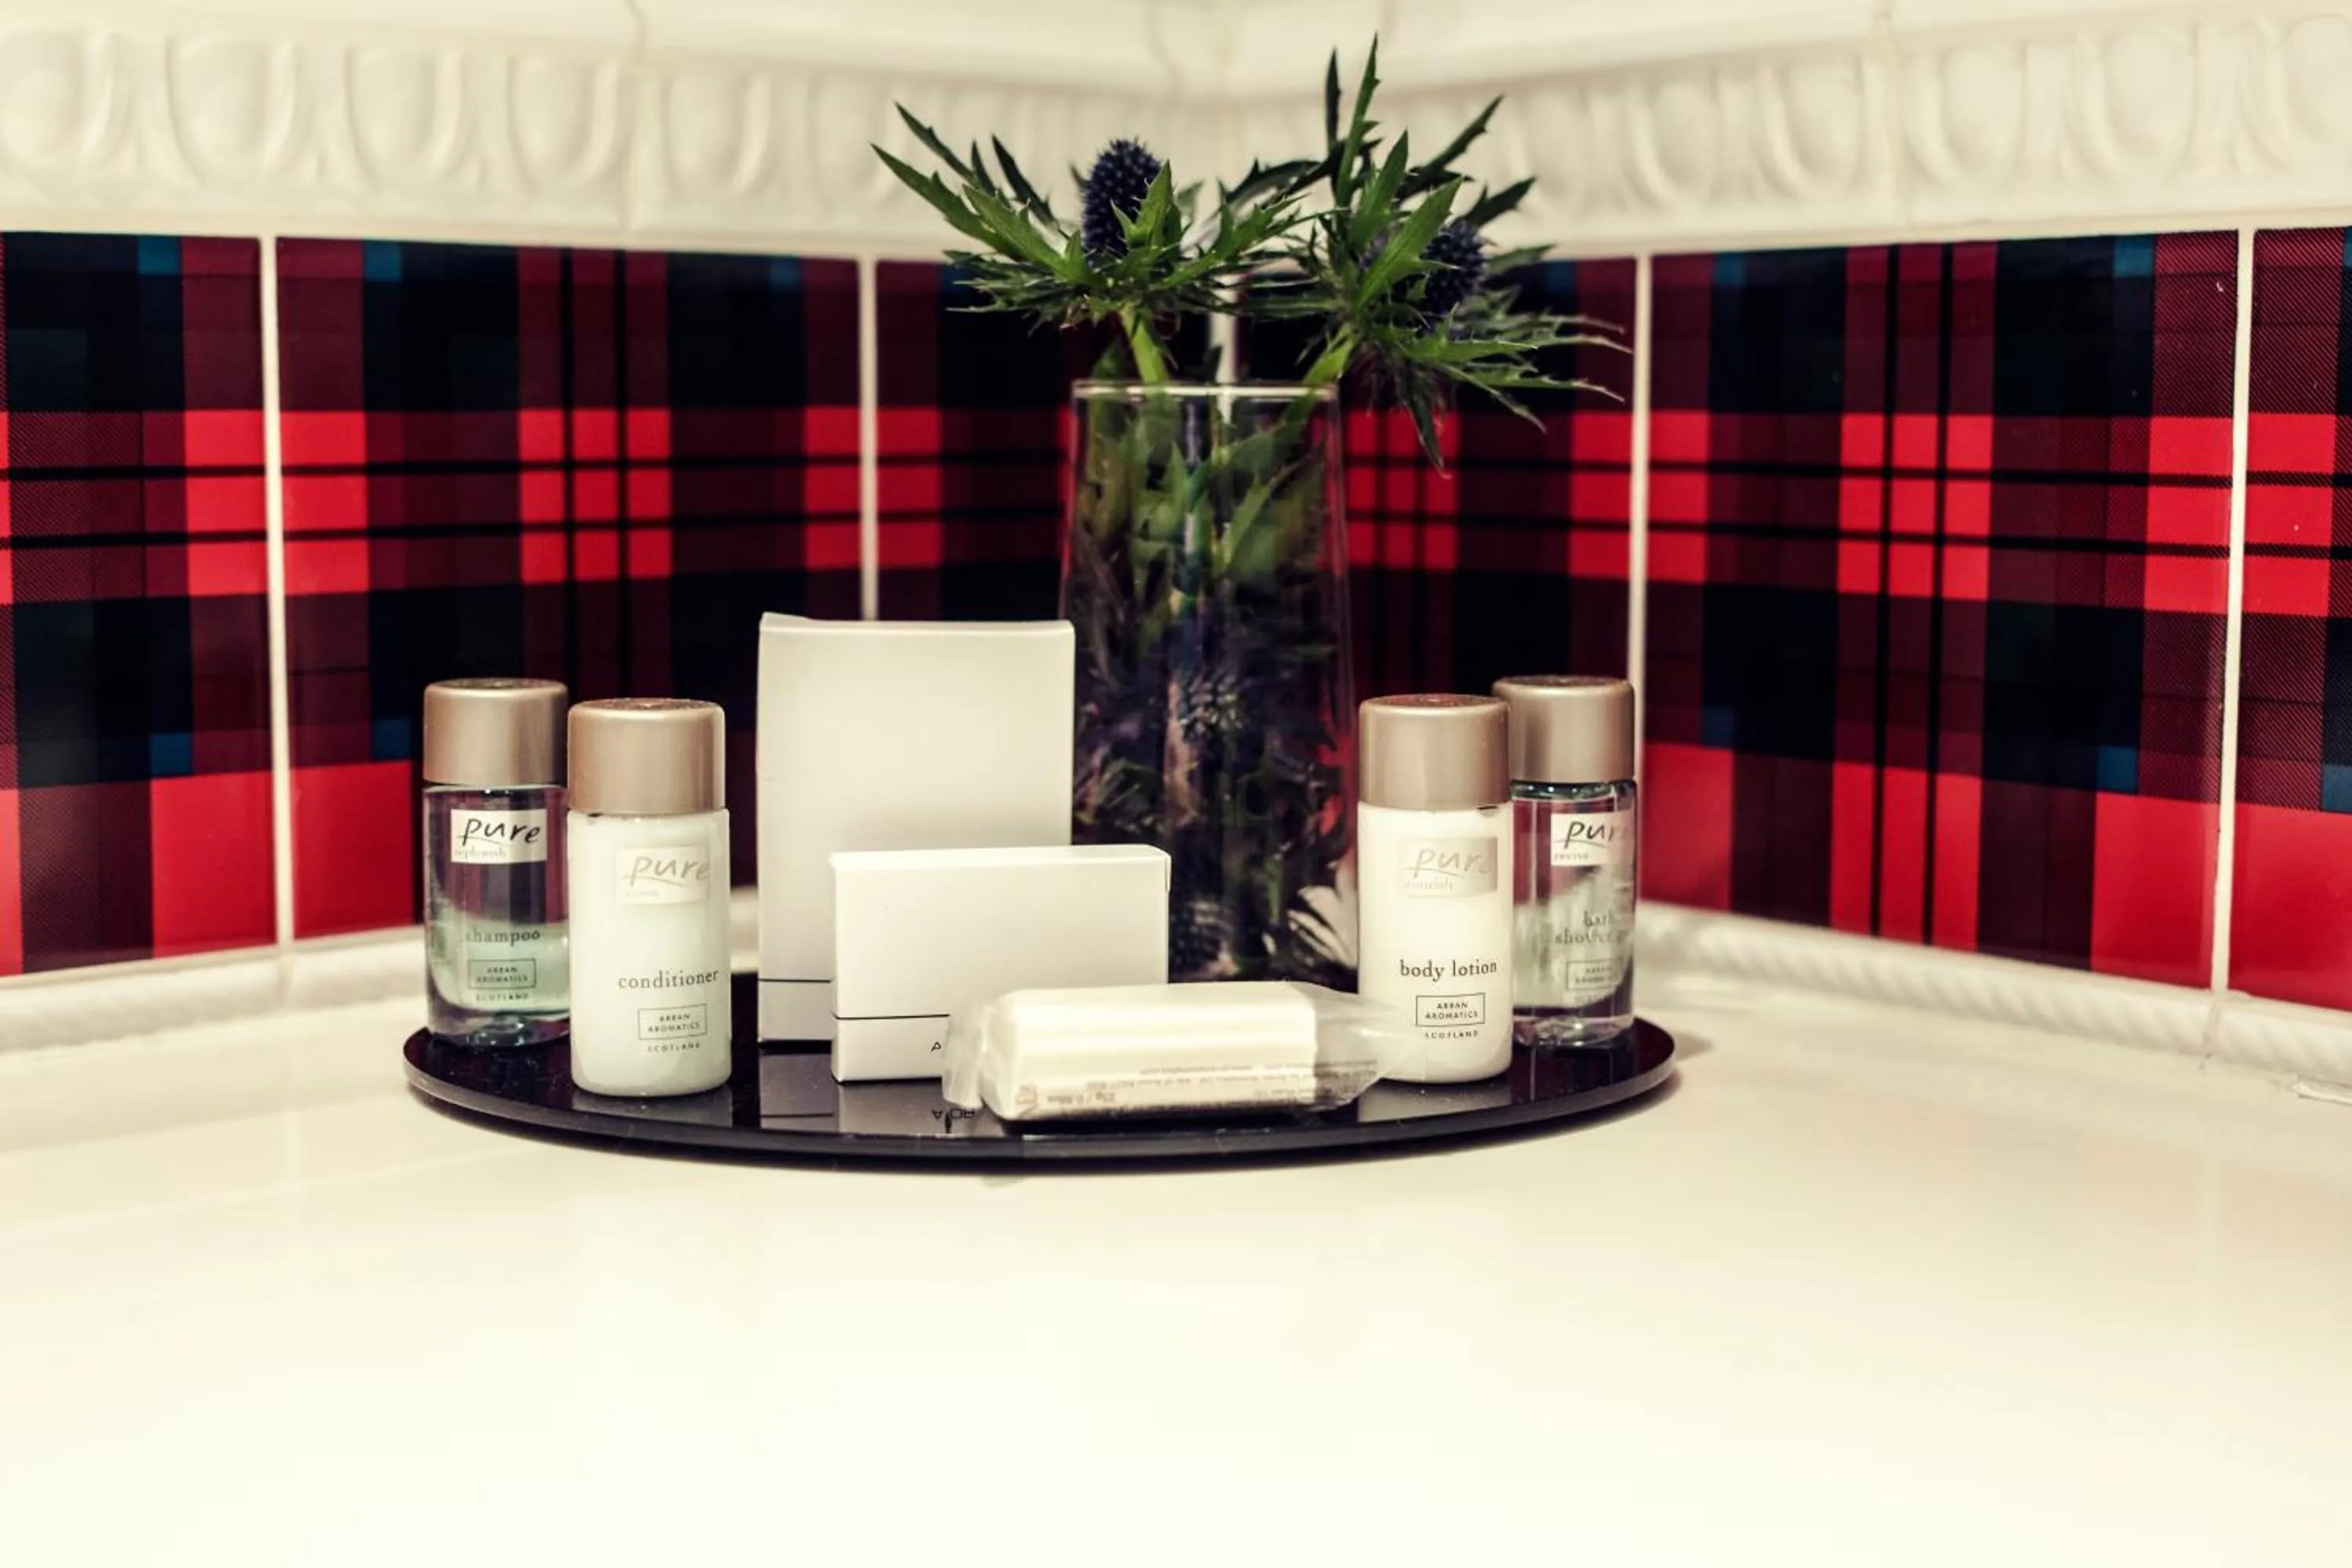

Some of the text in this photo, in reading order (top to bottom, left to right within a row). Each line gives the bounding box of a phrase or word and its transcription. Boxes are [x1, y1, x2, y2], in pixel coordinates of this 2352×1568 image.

[462, 818, 541, 847] pure
[630, 855, 711, 887] pure
[618, 969, 719, 989] conditioner
[1399, 958, 1497, 982] body lotion
[1425, 1010, 1479, 1020] AROMATICS
